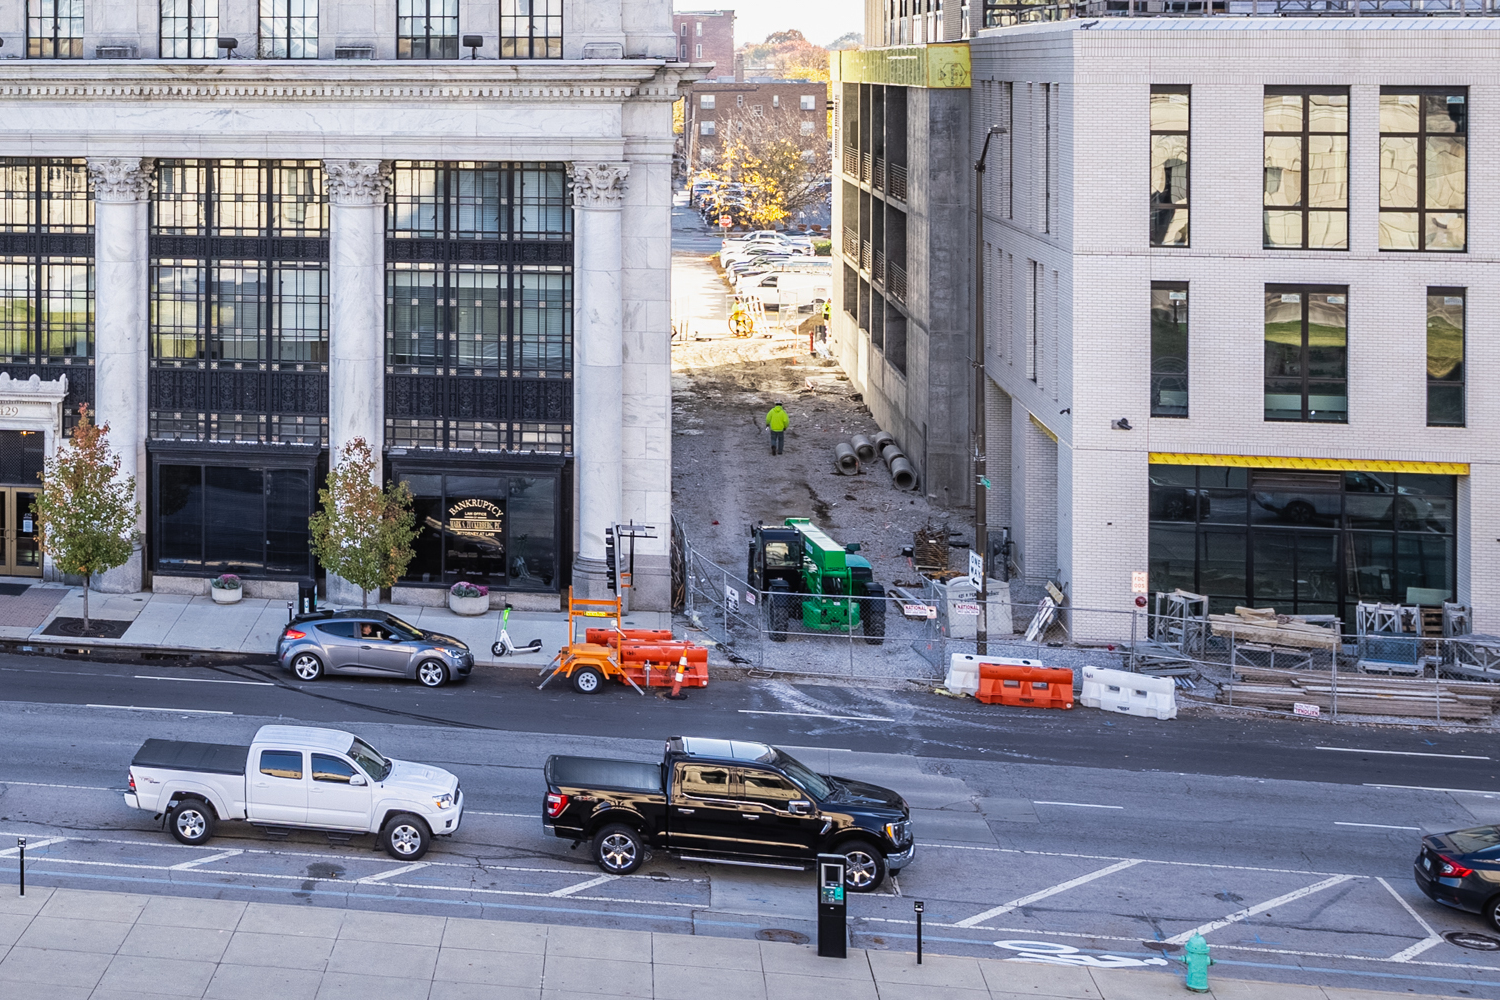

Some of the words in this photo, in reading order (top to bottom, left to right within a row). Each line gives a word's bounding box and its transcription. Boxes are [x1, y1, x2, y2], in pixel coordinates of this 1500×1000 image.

[448, 499, 504, 517] BANKRUPTCY
[970, 556, 981, 568] ONE
[971, 567, 981, 578] WAY
